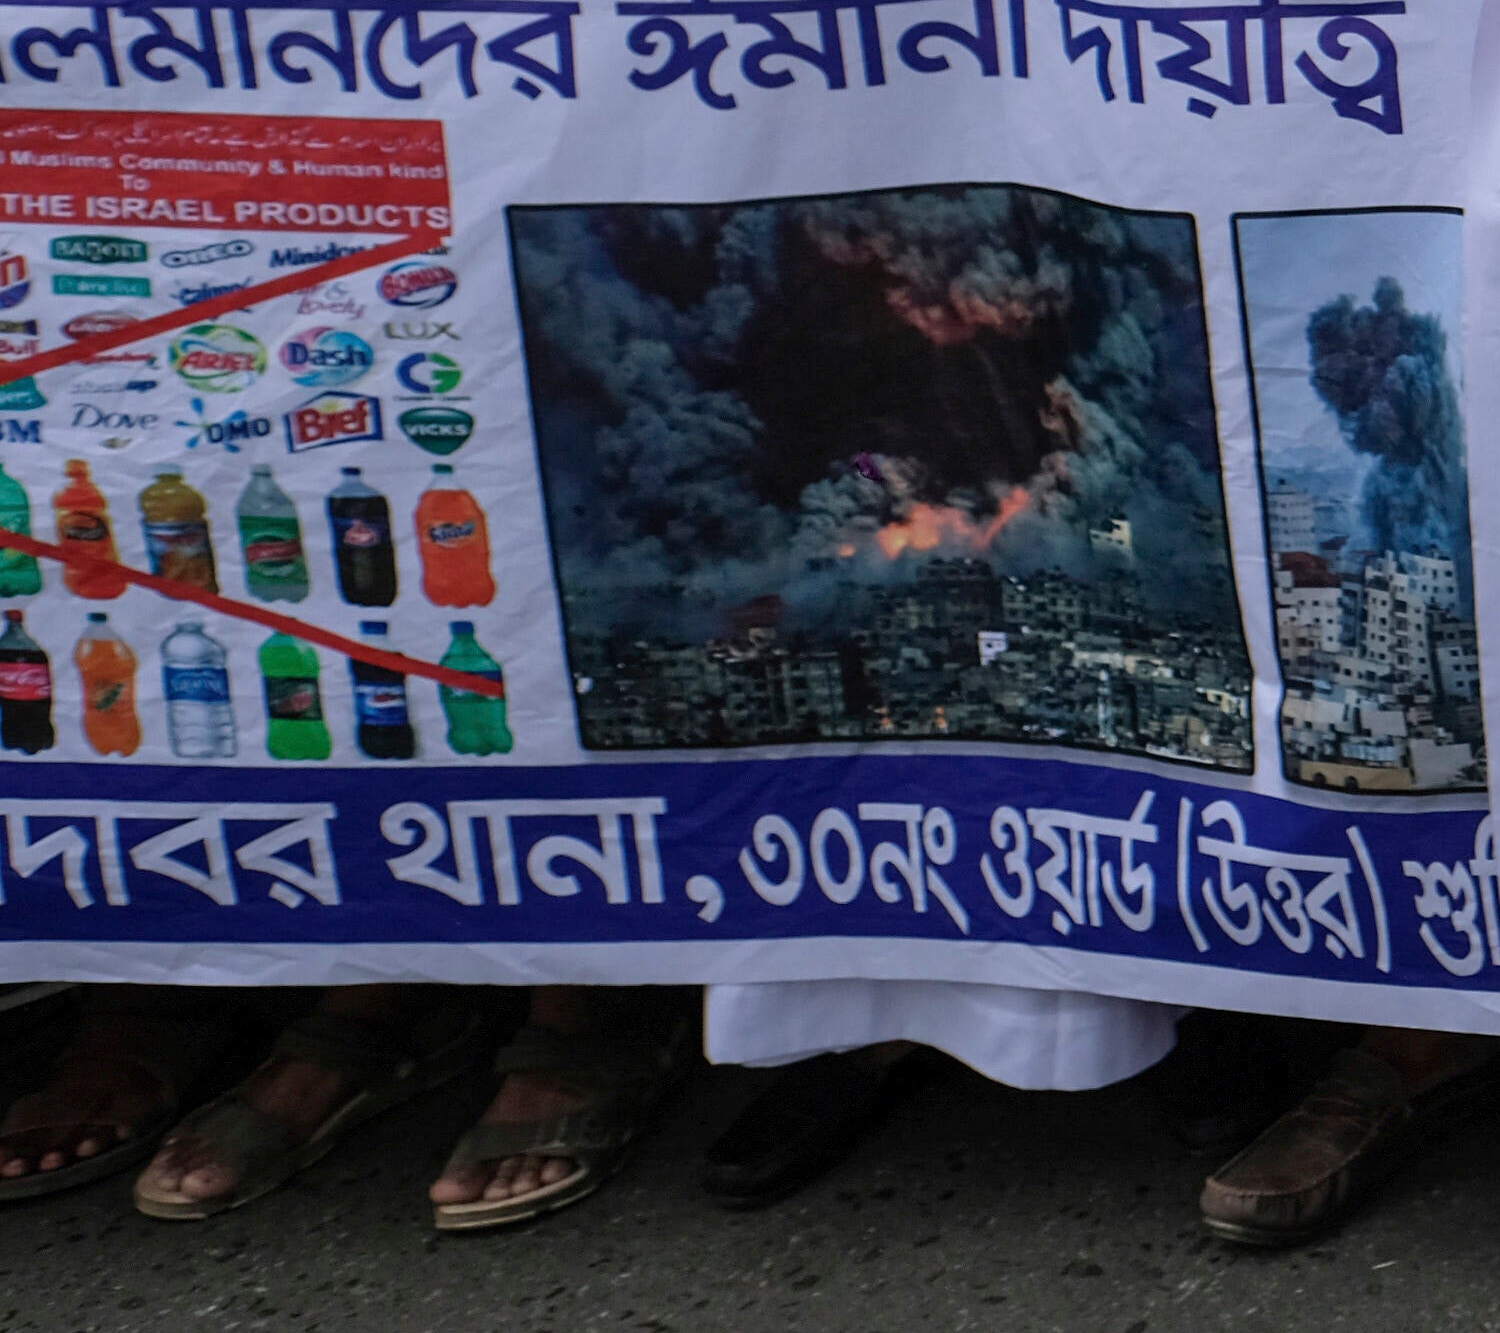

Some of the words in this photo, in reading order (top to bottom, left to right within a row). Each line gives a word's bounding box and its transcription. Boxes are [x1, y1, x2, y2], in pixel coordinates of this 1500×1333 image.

[119, 153, 261, 178] Community
[293, 161, 382, 179] Human
[390, 161, 445, 181] kind
[1, 193, 75, 218] THE
[86, 196, 225, 223] ISRAEL
[235, 202, 451, 229] PRODUCTS
[382, 321, 462, 340] LUX
[288, 339, 371, 367] Dash
[205, 416, 271, 443] OMO
[295, 398, 369, 444] Bref
[405, 423, 469, 437] VICKS
[0, 799, 342, 910] দাবর
[980, 789, 1159, 936] ওয়ার্ড
